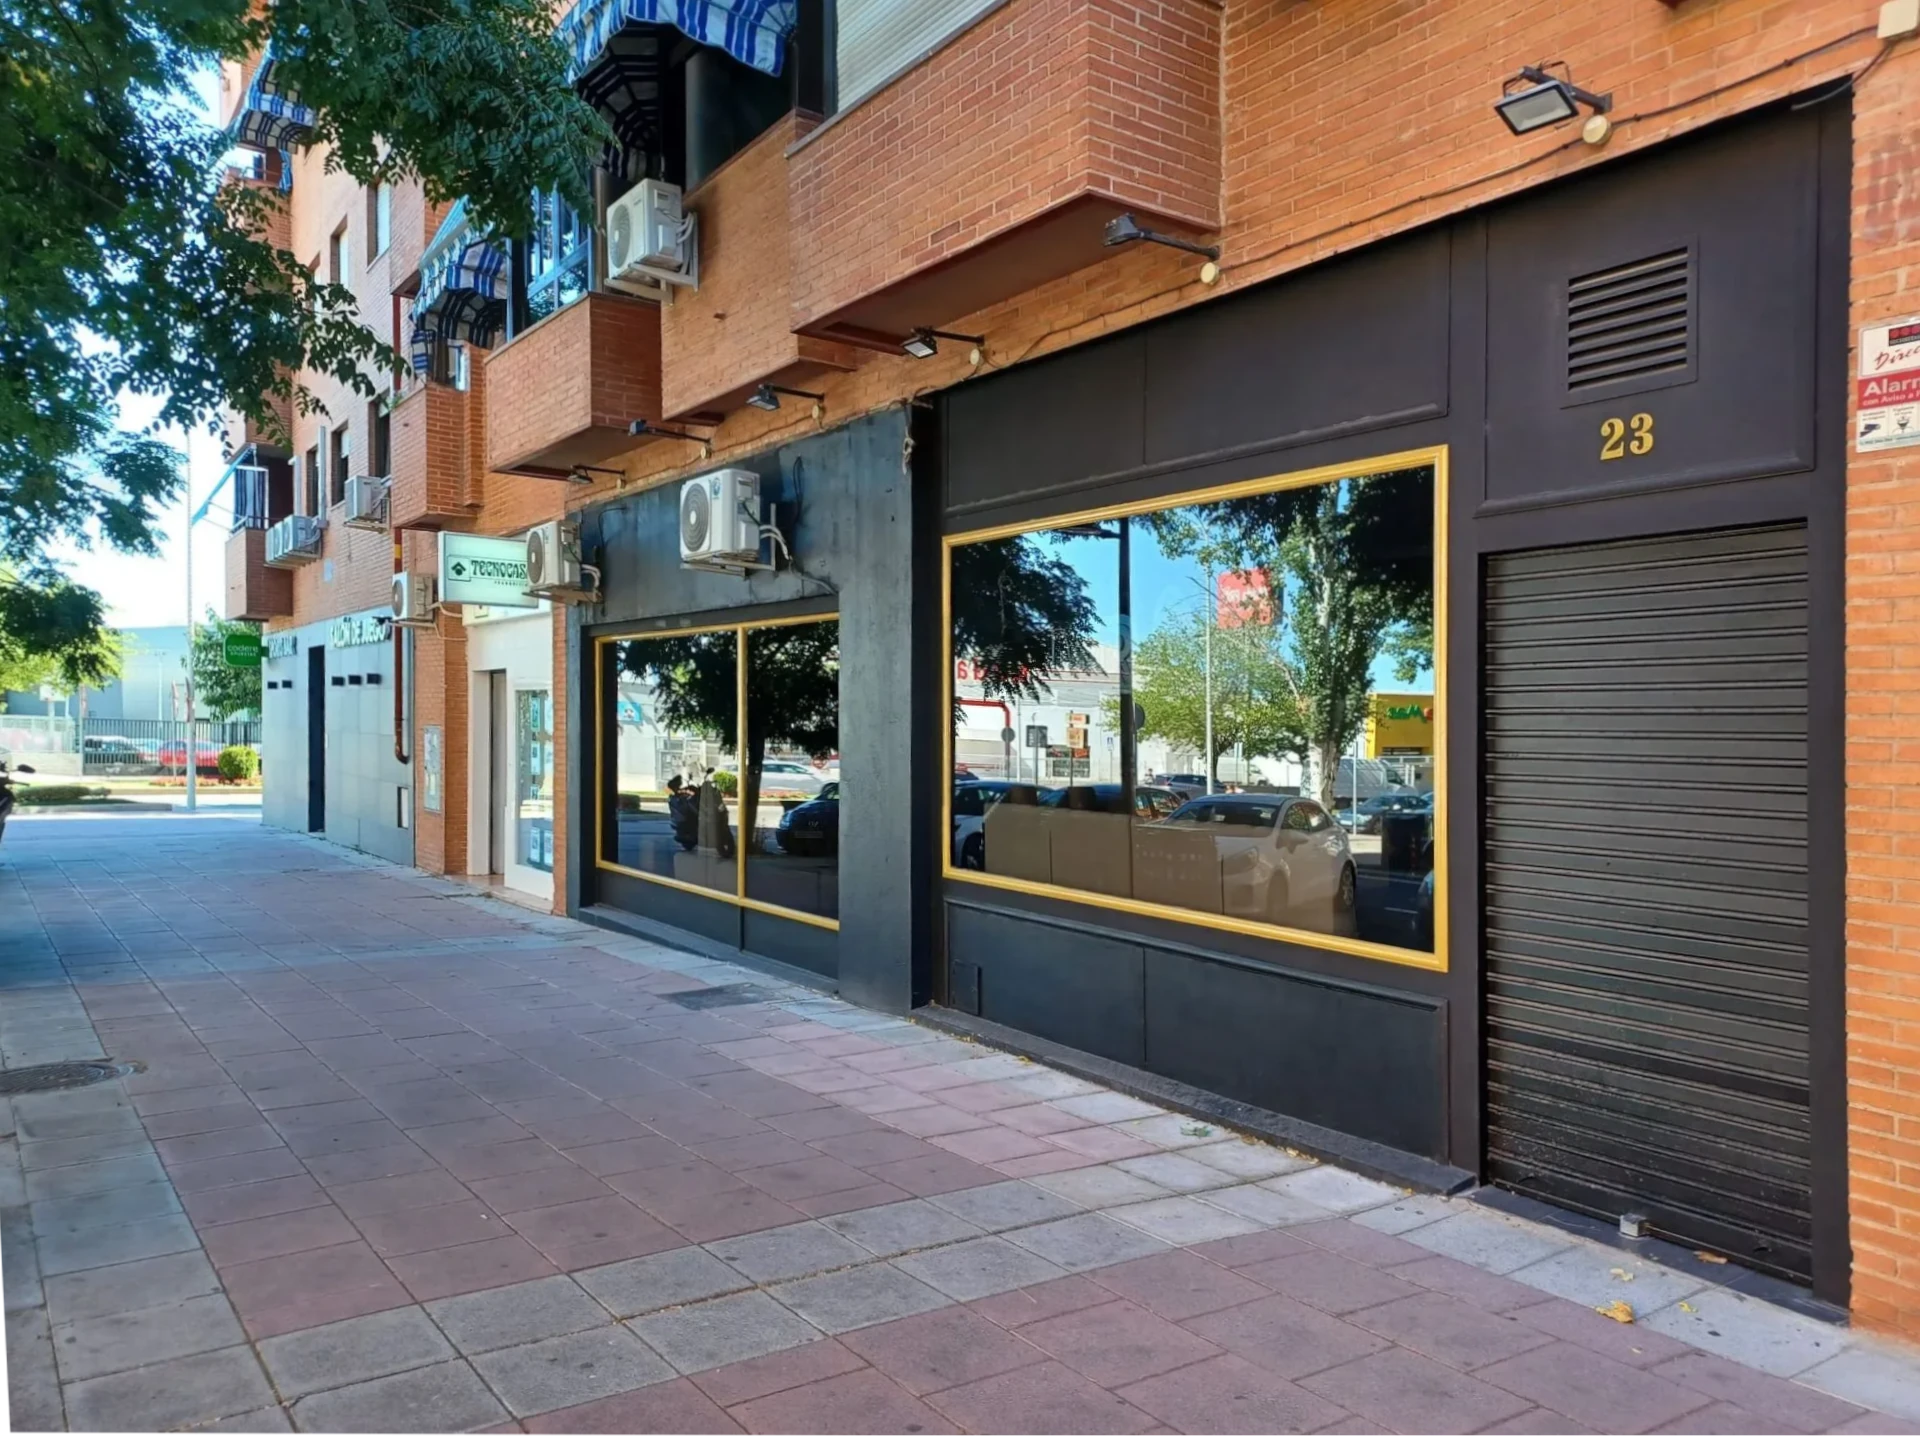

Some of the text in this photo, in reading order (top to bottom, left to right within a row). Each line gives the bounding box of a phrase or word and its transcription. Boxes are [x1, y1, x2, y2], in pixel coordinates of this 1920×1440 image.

[1880, 393, 1906, 404] Aviso
[1600, 412, 1654, 461] 23
[470, 560, 528, 580] TECNOCAS
